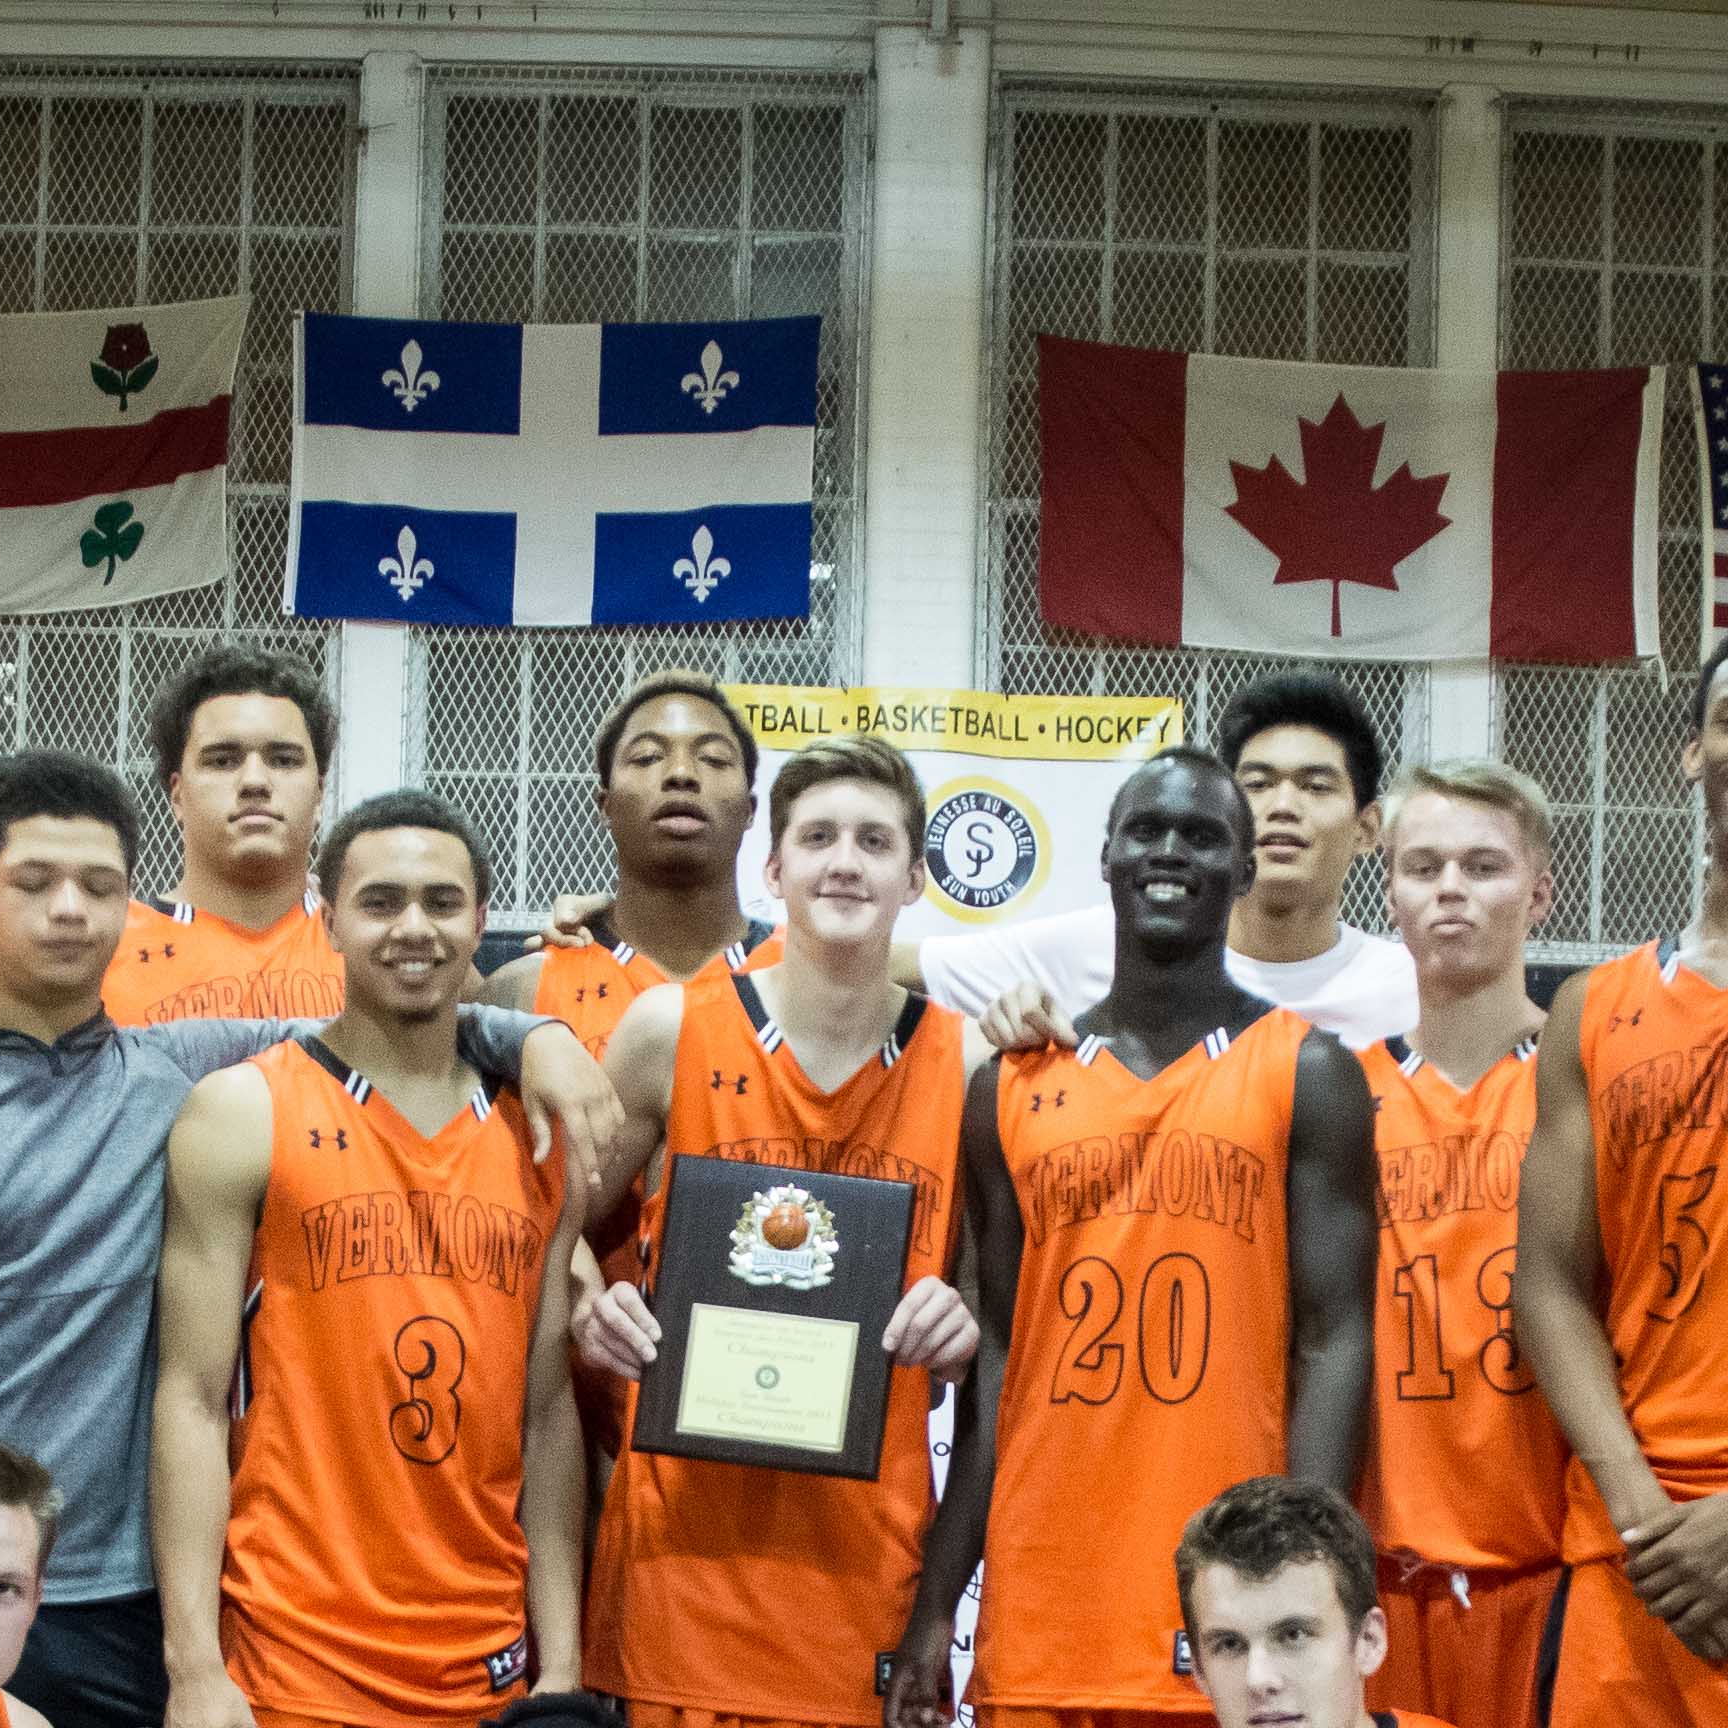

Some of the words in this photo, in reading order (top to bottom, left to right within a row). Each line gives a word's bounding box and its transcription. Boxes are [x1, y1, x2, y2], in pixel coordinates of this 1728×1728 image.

[745, 703, 832, 734] TBALL
[856, 703, 1030, 742] BASKETBALL
[1055, 714, 1171, 745] HOCKEY
[927, 794, 977, 850] JEUNESSE
[983, 797, 1003, 813] AU
[1003, 809, 1034, 858] SOLEIL
[941, 874, 970, 901] SUN
[973, 878, 1017, 906] YOUTH
[1022, 1128, 1265, 1245] VERMONT
[1050, 1251, 1212, 1406] 20
[388, 1313, 466, 1466] 3
